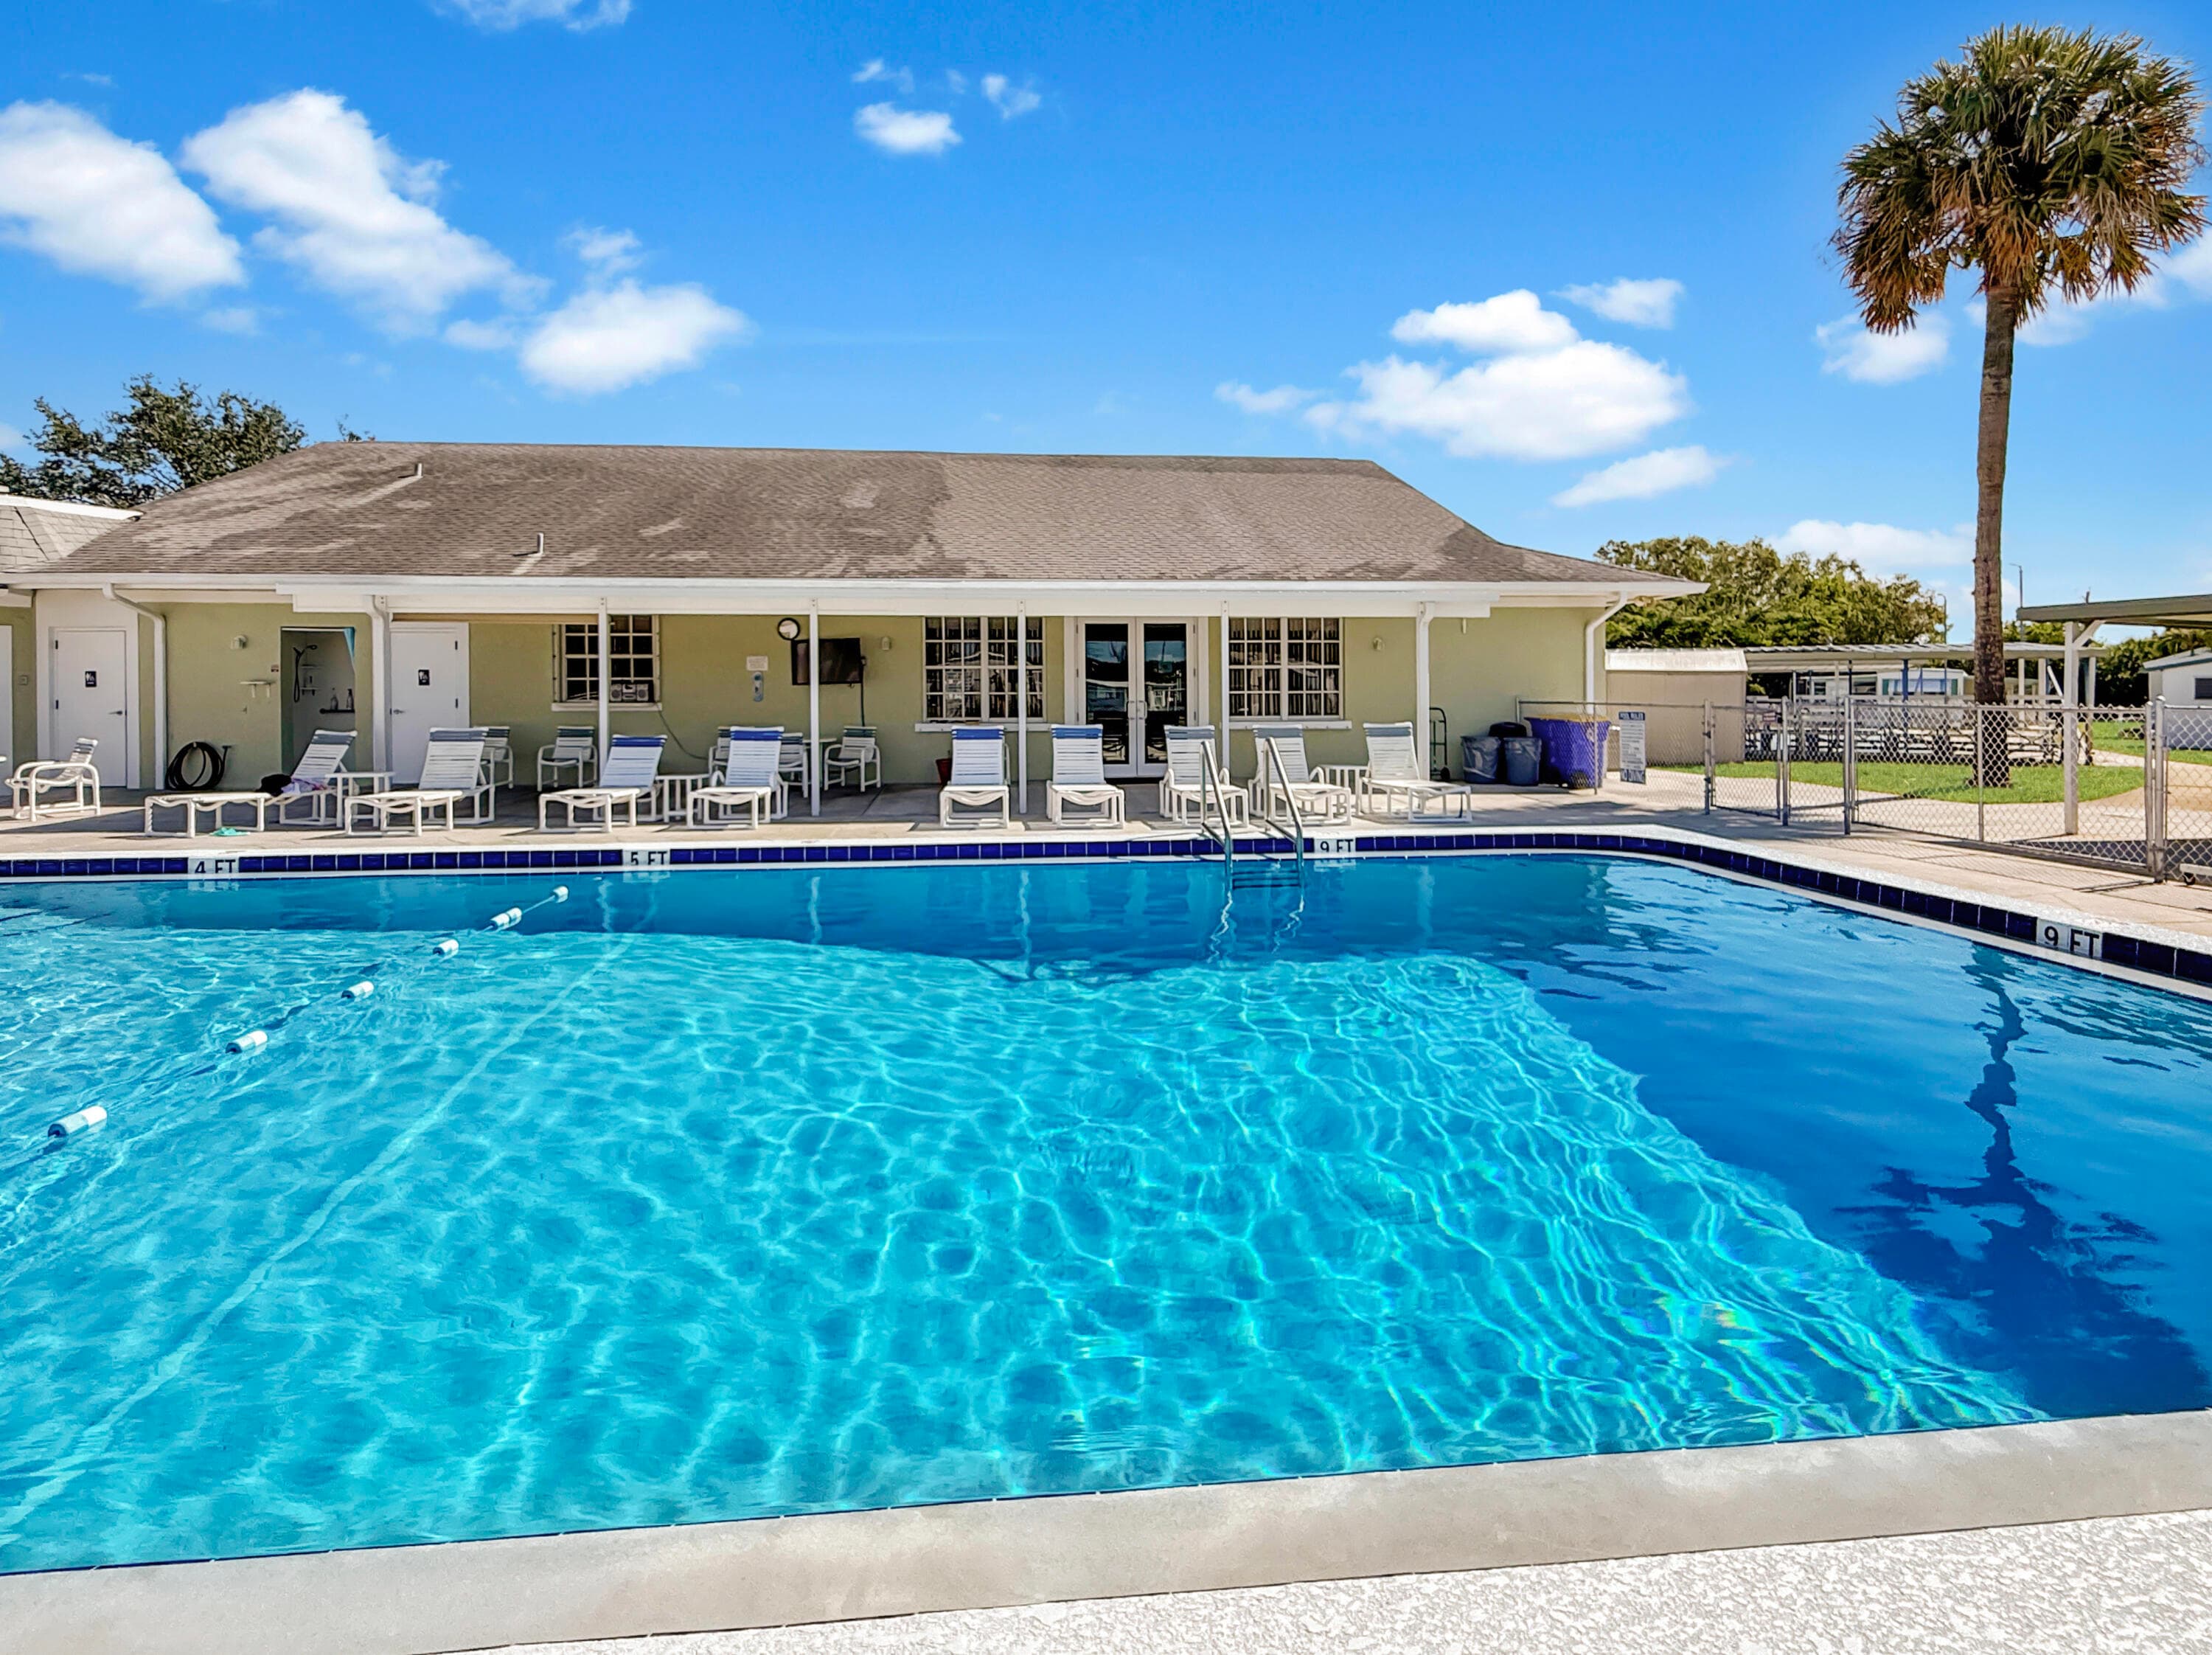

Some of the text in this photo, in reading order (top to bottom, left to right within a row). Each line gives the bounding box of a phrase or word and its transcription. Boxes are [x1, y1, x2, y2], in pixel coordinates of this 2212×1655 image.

[1321, 839, 1354, 853] 9 FT
[631, 851, 667, 865] 5 FT
[195, 859, 236, 874] 4 FT
[2045, 926, 2100, 959] 9 FT
